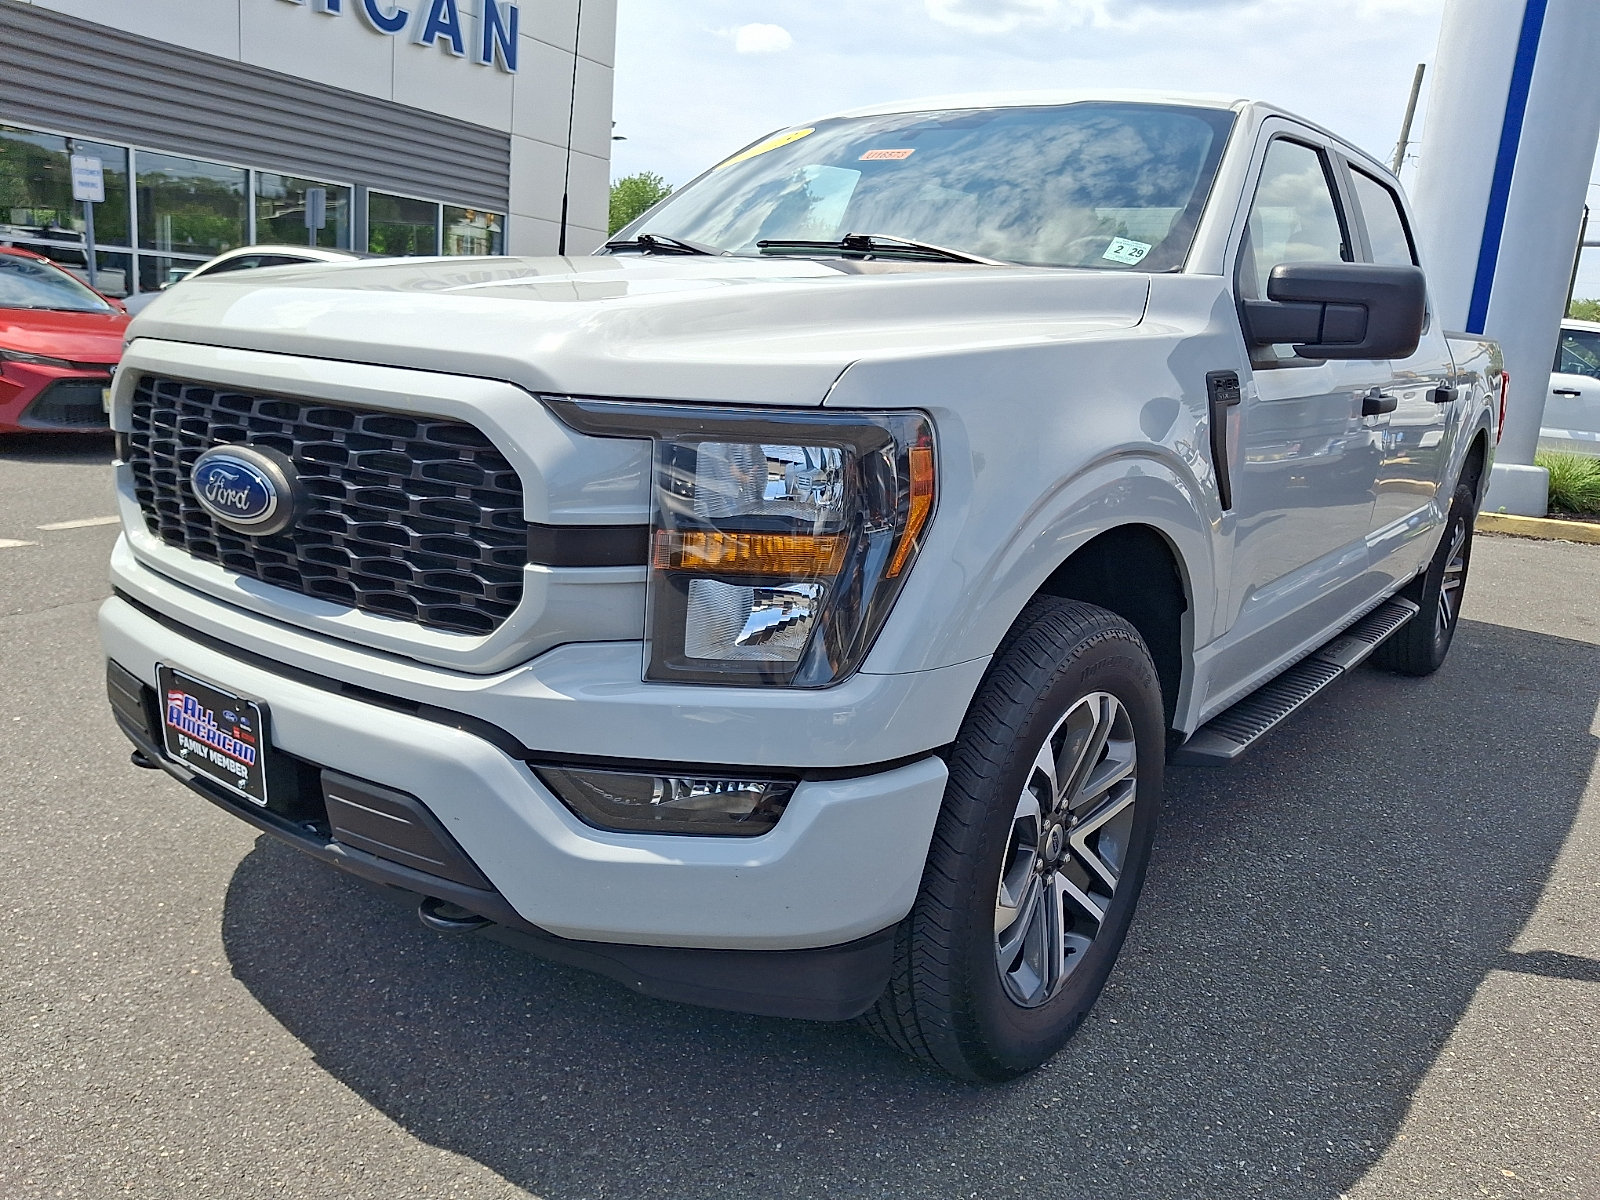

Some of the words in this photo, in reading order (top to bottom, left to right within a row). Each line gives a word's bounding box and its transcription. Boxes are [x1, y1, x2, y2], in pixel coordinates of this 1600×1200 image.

[285, 0, 520, 74] CAN
[1114, 245, 1124, 254] 2
[1128, 247, 1144, 258] 29
[205, 467, 250, 510] Ford
[178, 734, 209, 759] FAMILY
[209, 747, 248, 780] MEMBER
